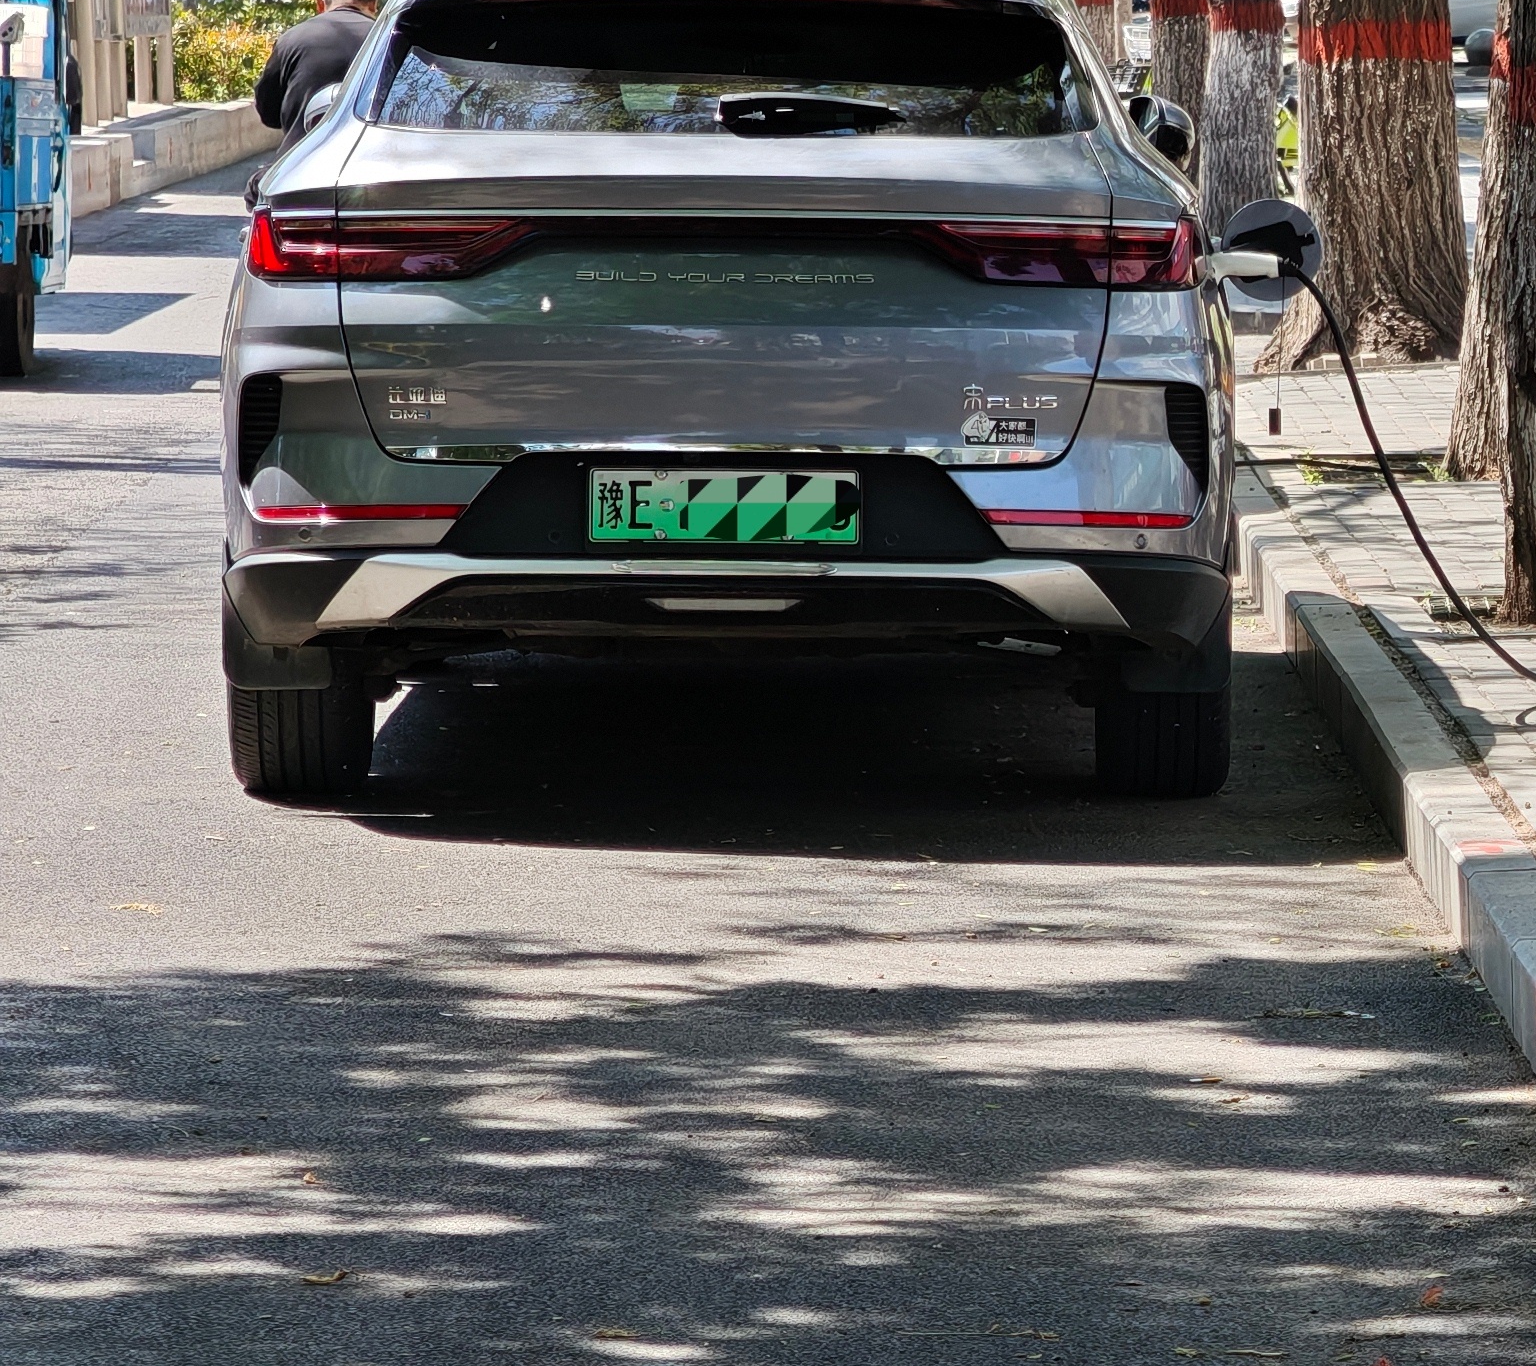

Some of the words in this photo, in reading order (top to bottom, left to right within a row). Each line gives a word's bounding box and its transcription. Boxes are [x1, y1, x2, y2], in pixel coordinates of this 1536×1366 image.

[575, 270, 657, 282] BUILD
[667, 272, 746, 283] YOUR
[753, 273, 875, 284] DREAMS
[388, 386, 447, 404] 比亚迪
